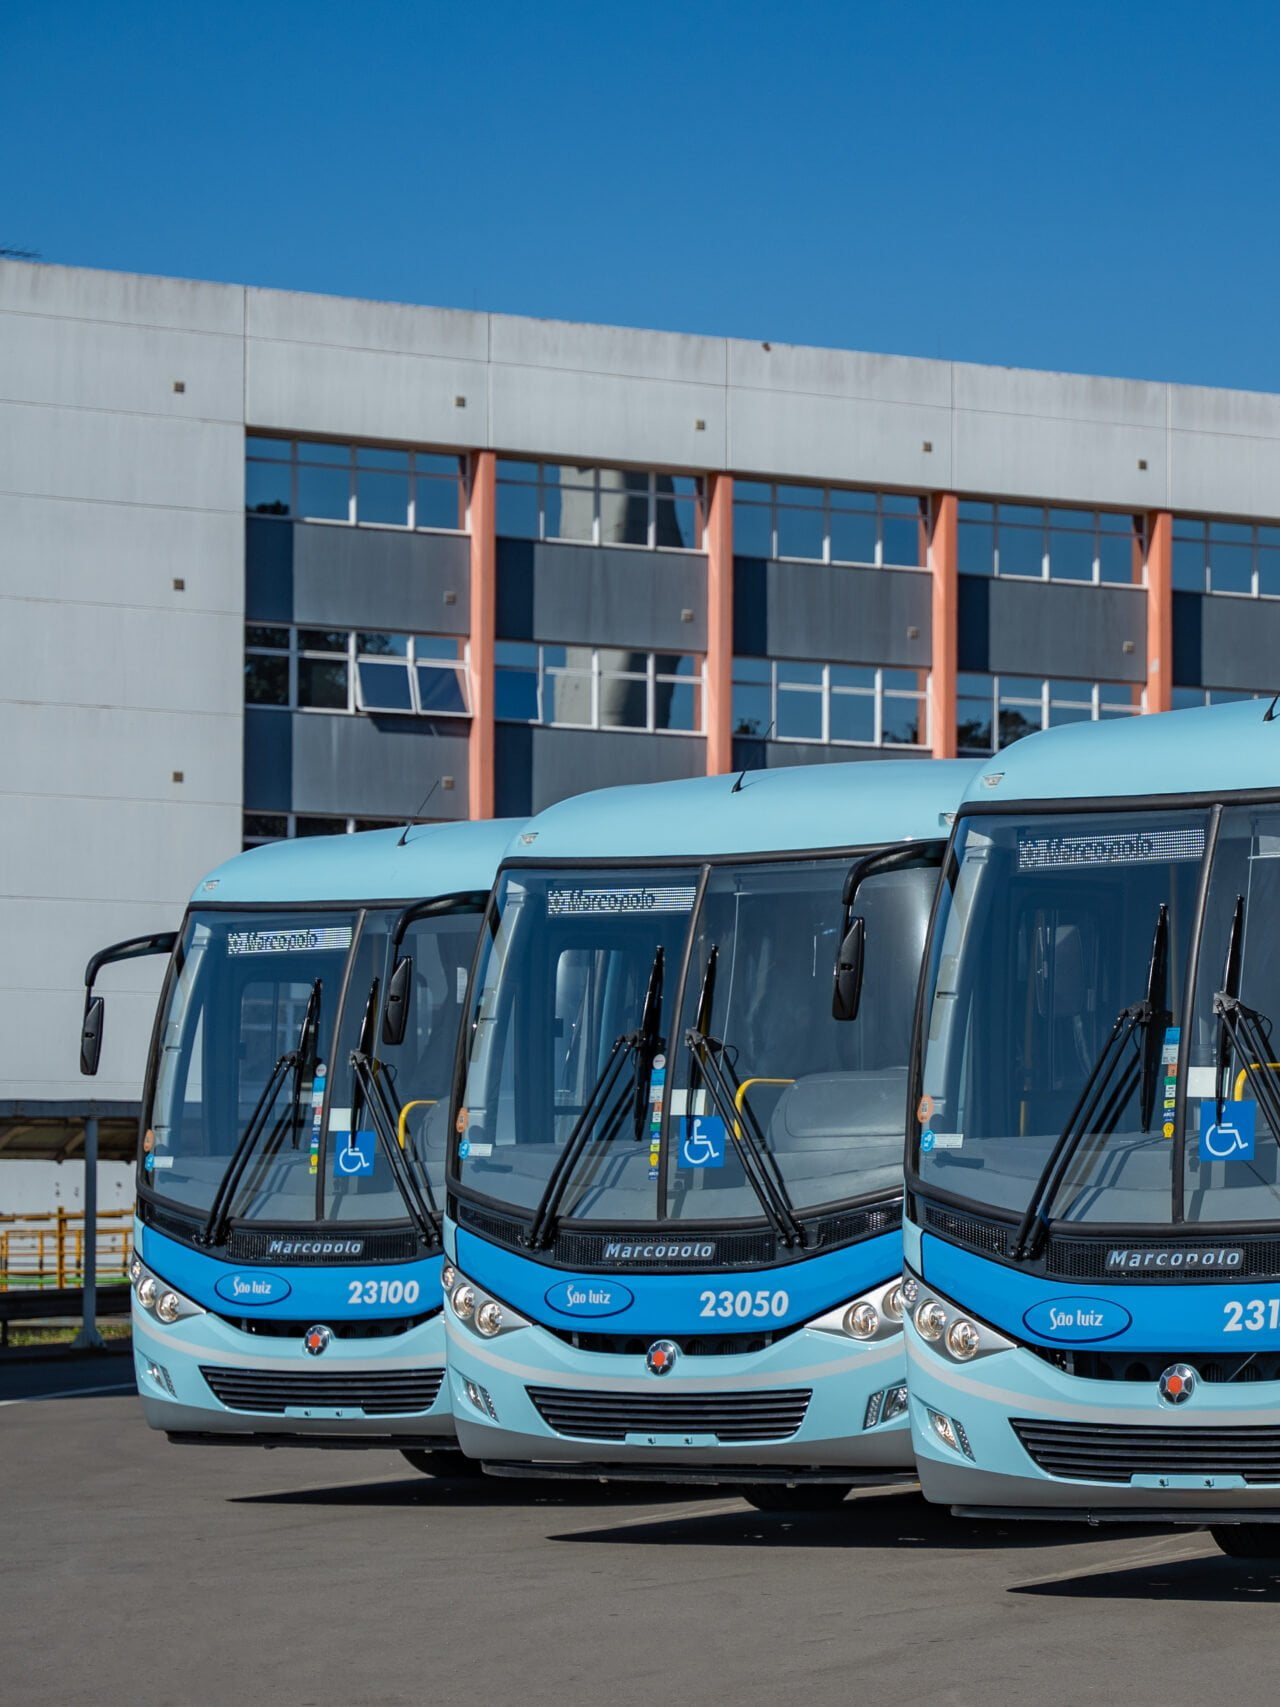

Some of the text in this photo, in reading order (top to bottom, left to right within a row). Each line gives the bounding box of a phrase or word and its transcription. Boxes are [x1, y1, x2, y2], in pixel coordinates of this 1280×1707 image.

[1049, 832, 1153, 867] Marcopolo
[569, 887, 656, 914] Marcopolo
[269, 1240, 361, 1254] Marcopolo
[605, 1243, 713, 1259] Marcopolo
[1109, 1249, 1241, 1268] Marcopolo
[233, 1276, 250, 1296] São
[348, 1280, 420, 1304] 23100
[566, 1284, 586, 1307] São
[699, 1290, 789, 1317] 23050
[1049, 1307, 1074, 1330] São
